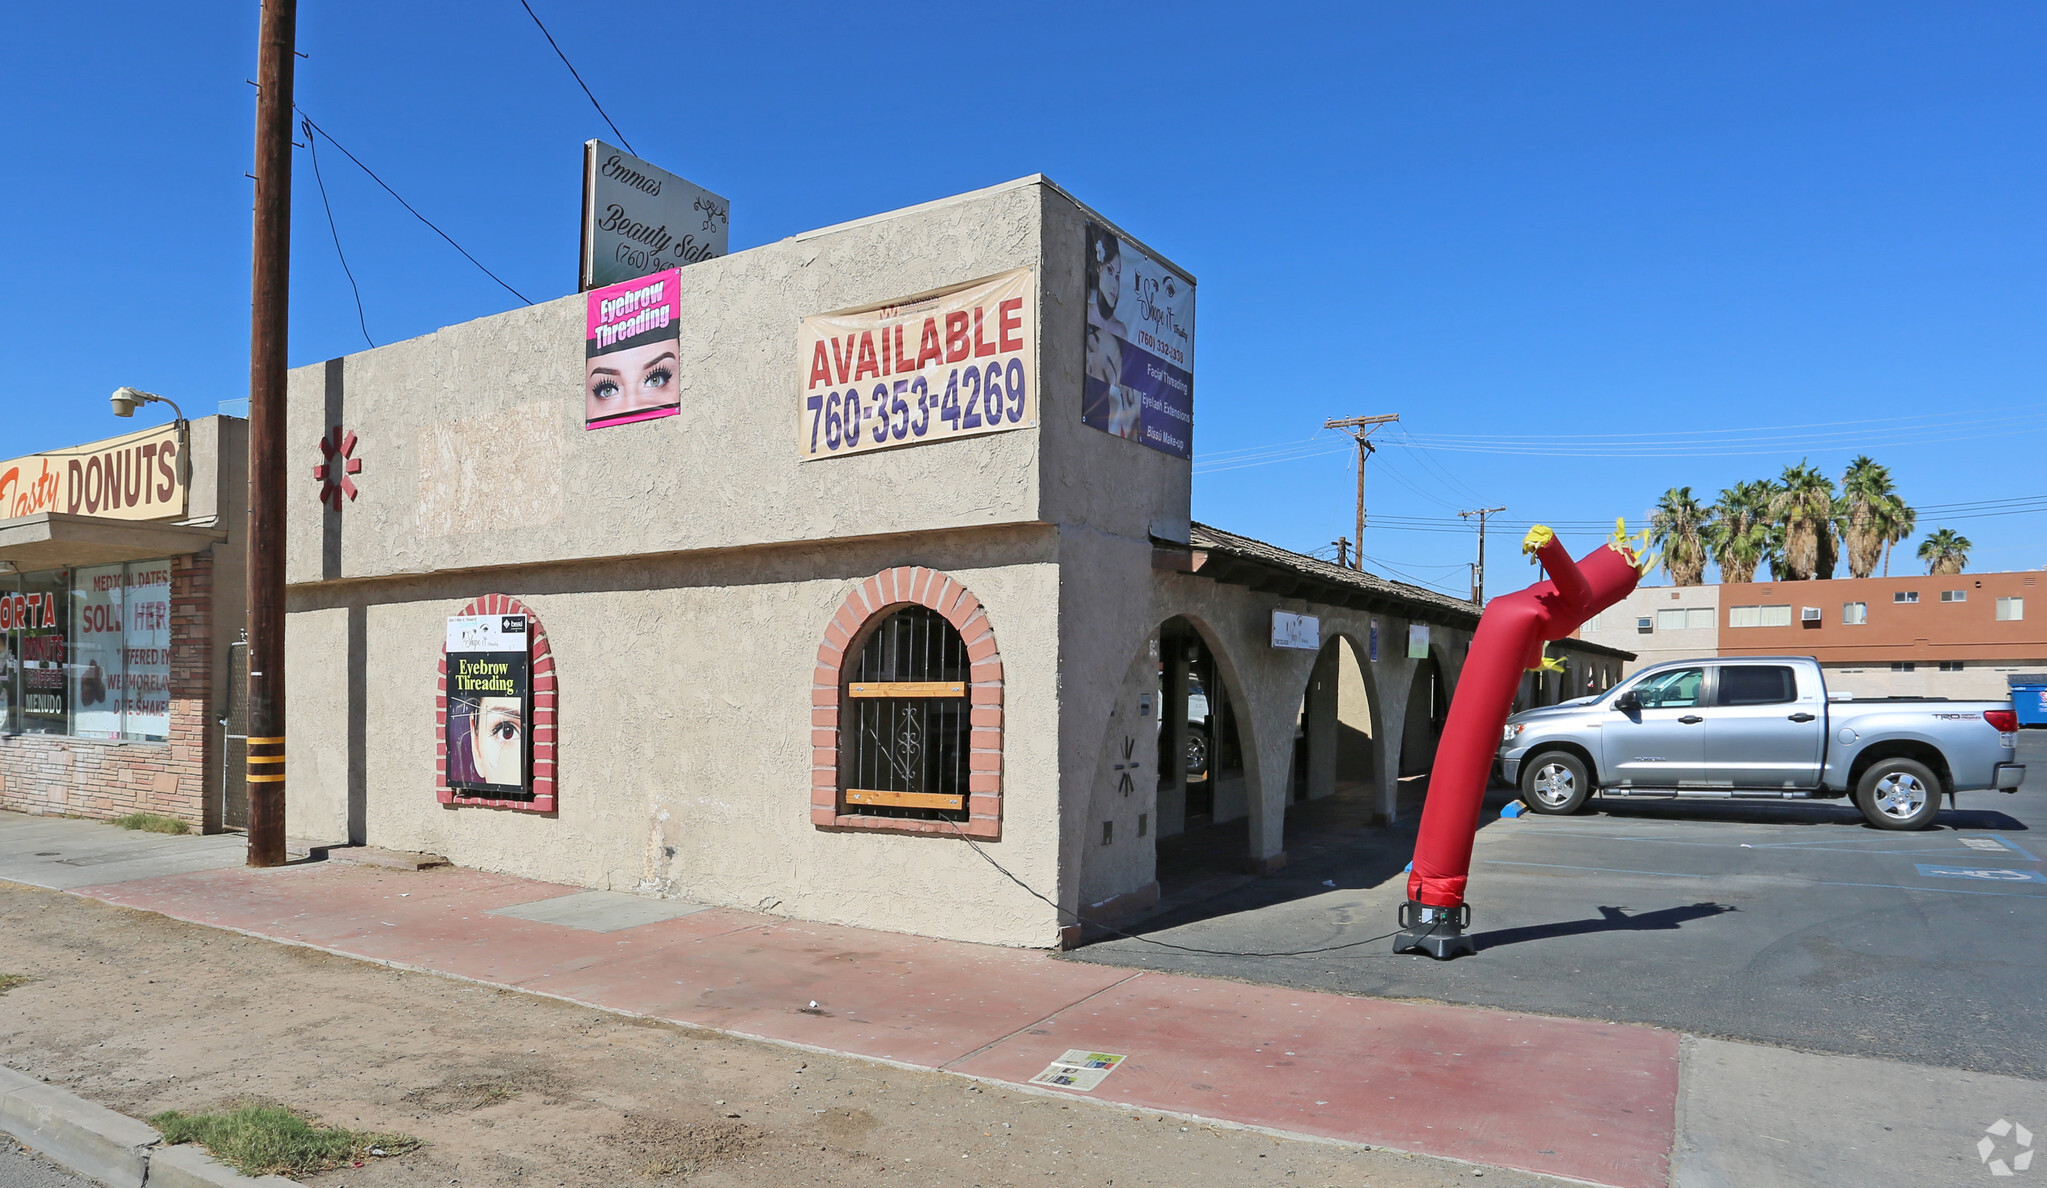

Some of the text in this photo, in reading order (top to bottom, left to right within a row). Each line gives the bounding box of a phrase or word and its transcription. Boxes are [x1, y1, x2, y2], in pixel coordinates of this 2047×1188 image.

[601, 155, 662, 197] Emmas
[598, 203, 721, 264] Beauty Salo
[615, 242, 650, 272] (760)
[600, 280, 665, 324] Eyebrow
[1140, 278, 1164, 335] Shape
[1166, 305, 1174, 331] it
[594, 303, 671, 350] Threading
[1137, 329, 1156, 352] (760)
[808, 297, 1024, 390] AVAILABLE
[1147, 363, 1188, 396] Facial Threading
[807, 357, 1026, 454] 760-353-4269
[1142, 392, 1191, 423] Eyelash Extensions
[1162, 431, 1184, 452] Make-up
[0, 440, 176, 519] Tasty DONUTS
[138, 570, 168, 588] DATES
[0, 592, 56, 630] ORTA
[24, 634, 64, 662] DONUTS
[26, 669, 63, 689] COFFEE
[459, 659, 508, 676] Eyebrow
[455, 674, 514, 695] Threading
[25, 694, 62, 715] MENUDO
